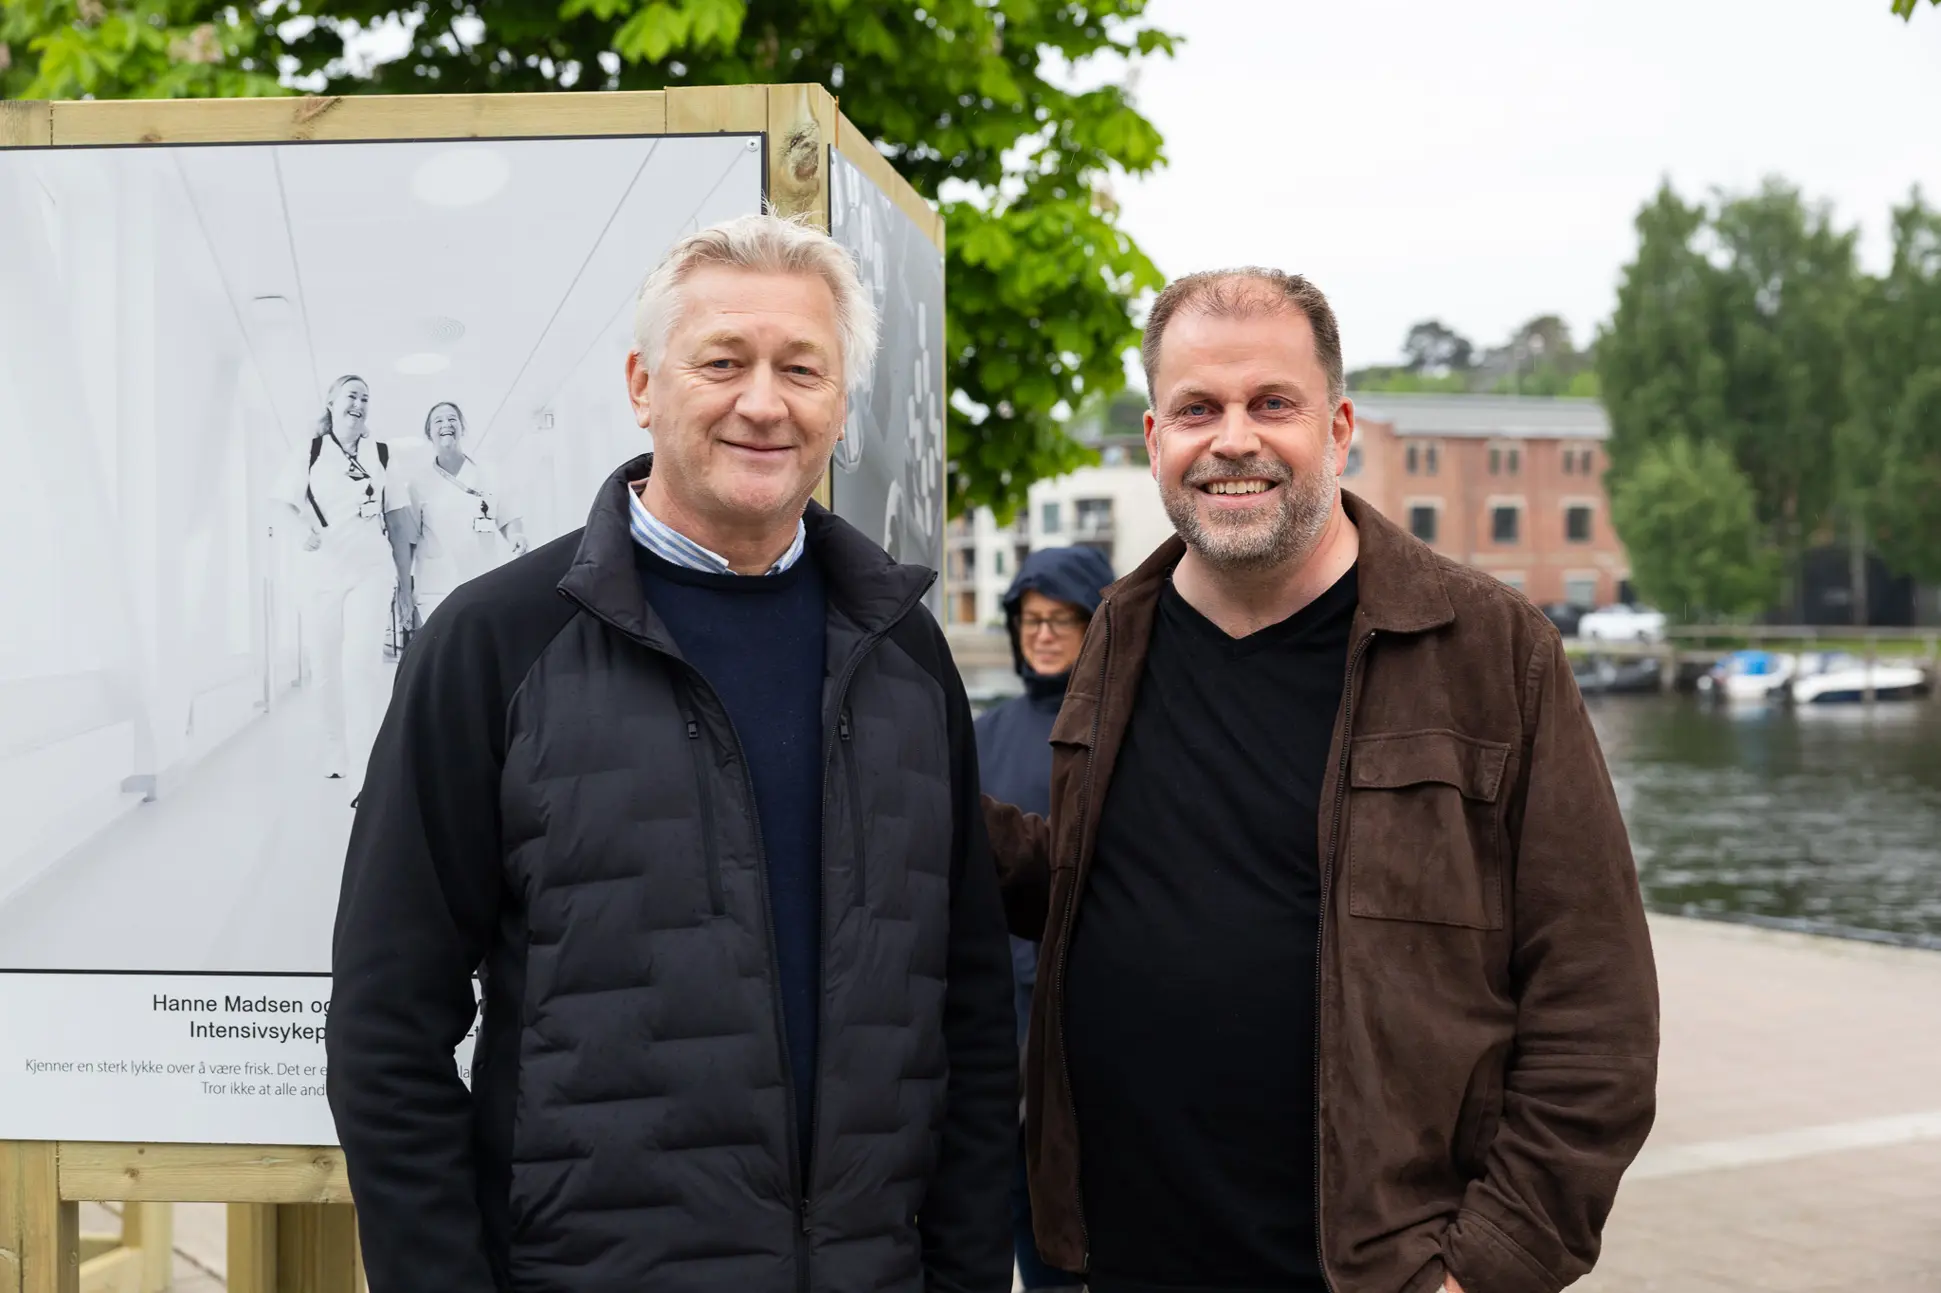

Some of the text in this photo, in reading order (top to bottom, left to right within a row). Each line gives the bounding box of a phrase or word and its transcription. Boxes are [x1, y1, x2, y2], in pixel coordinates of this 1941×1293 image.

[153, 994, 217, 1012] Hanne
[225, 995, 303, 1013] Madsen
[190, 1021, 326, 1044] Intensivsykep
[25, 1059, 74, 1075] Kjenner
[77, 1062, 94, 1073] en
[97, 1060, 128, 1074] sterk
[130, 1060, 164, 1076] lykke
[166, 1063, 196, 1074] over
[198, 1061, 206, 1075] å
[209, 1064, 242, 1075] være
[244, 1061, 274, 1076] frisk.
[277, 1062, 301, 1076] Det
[303, 1065, 316, 1077] er
[201, 1081, 227, 1095] Tror
[230, 1081, 256, 1096] ikke
[258, 1083, 272, 1096] at
[275, 1082, 298, 1097] alle
